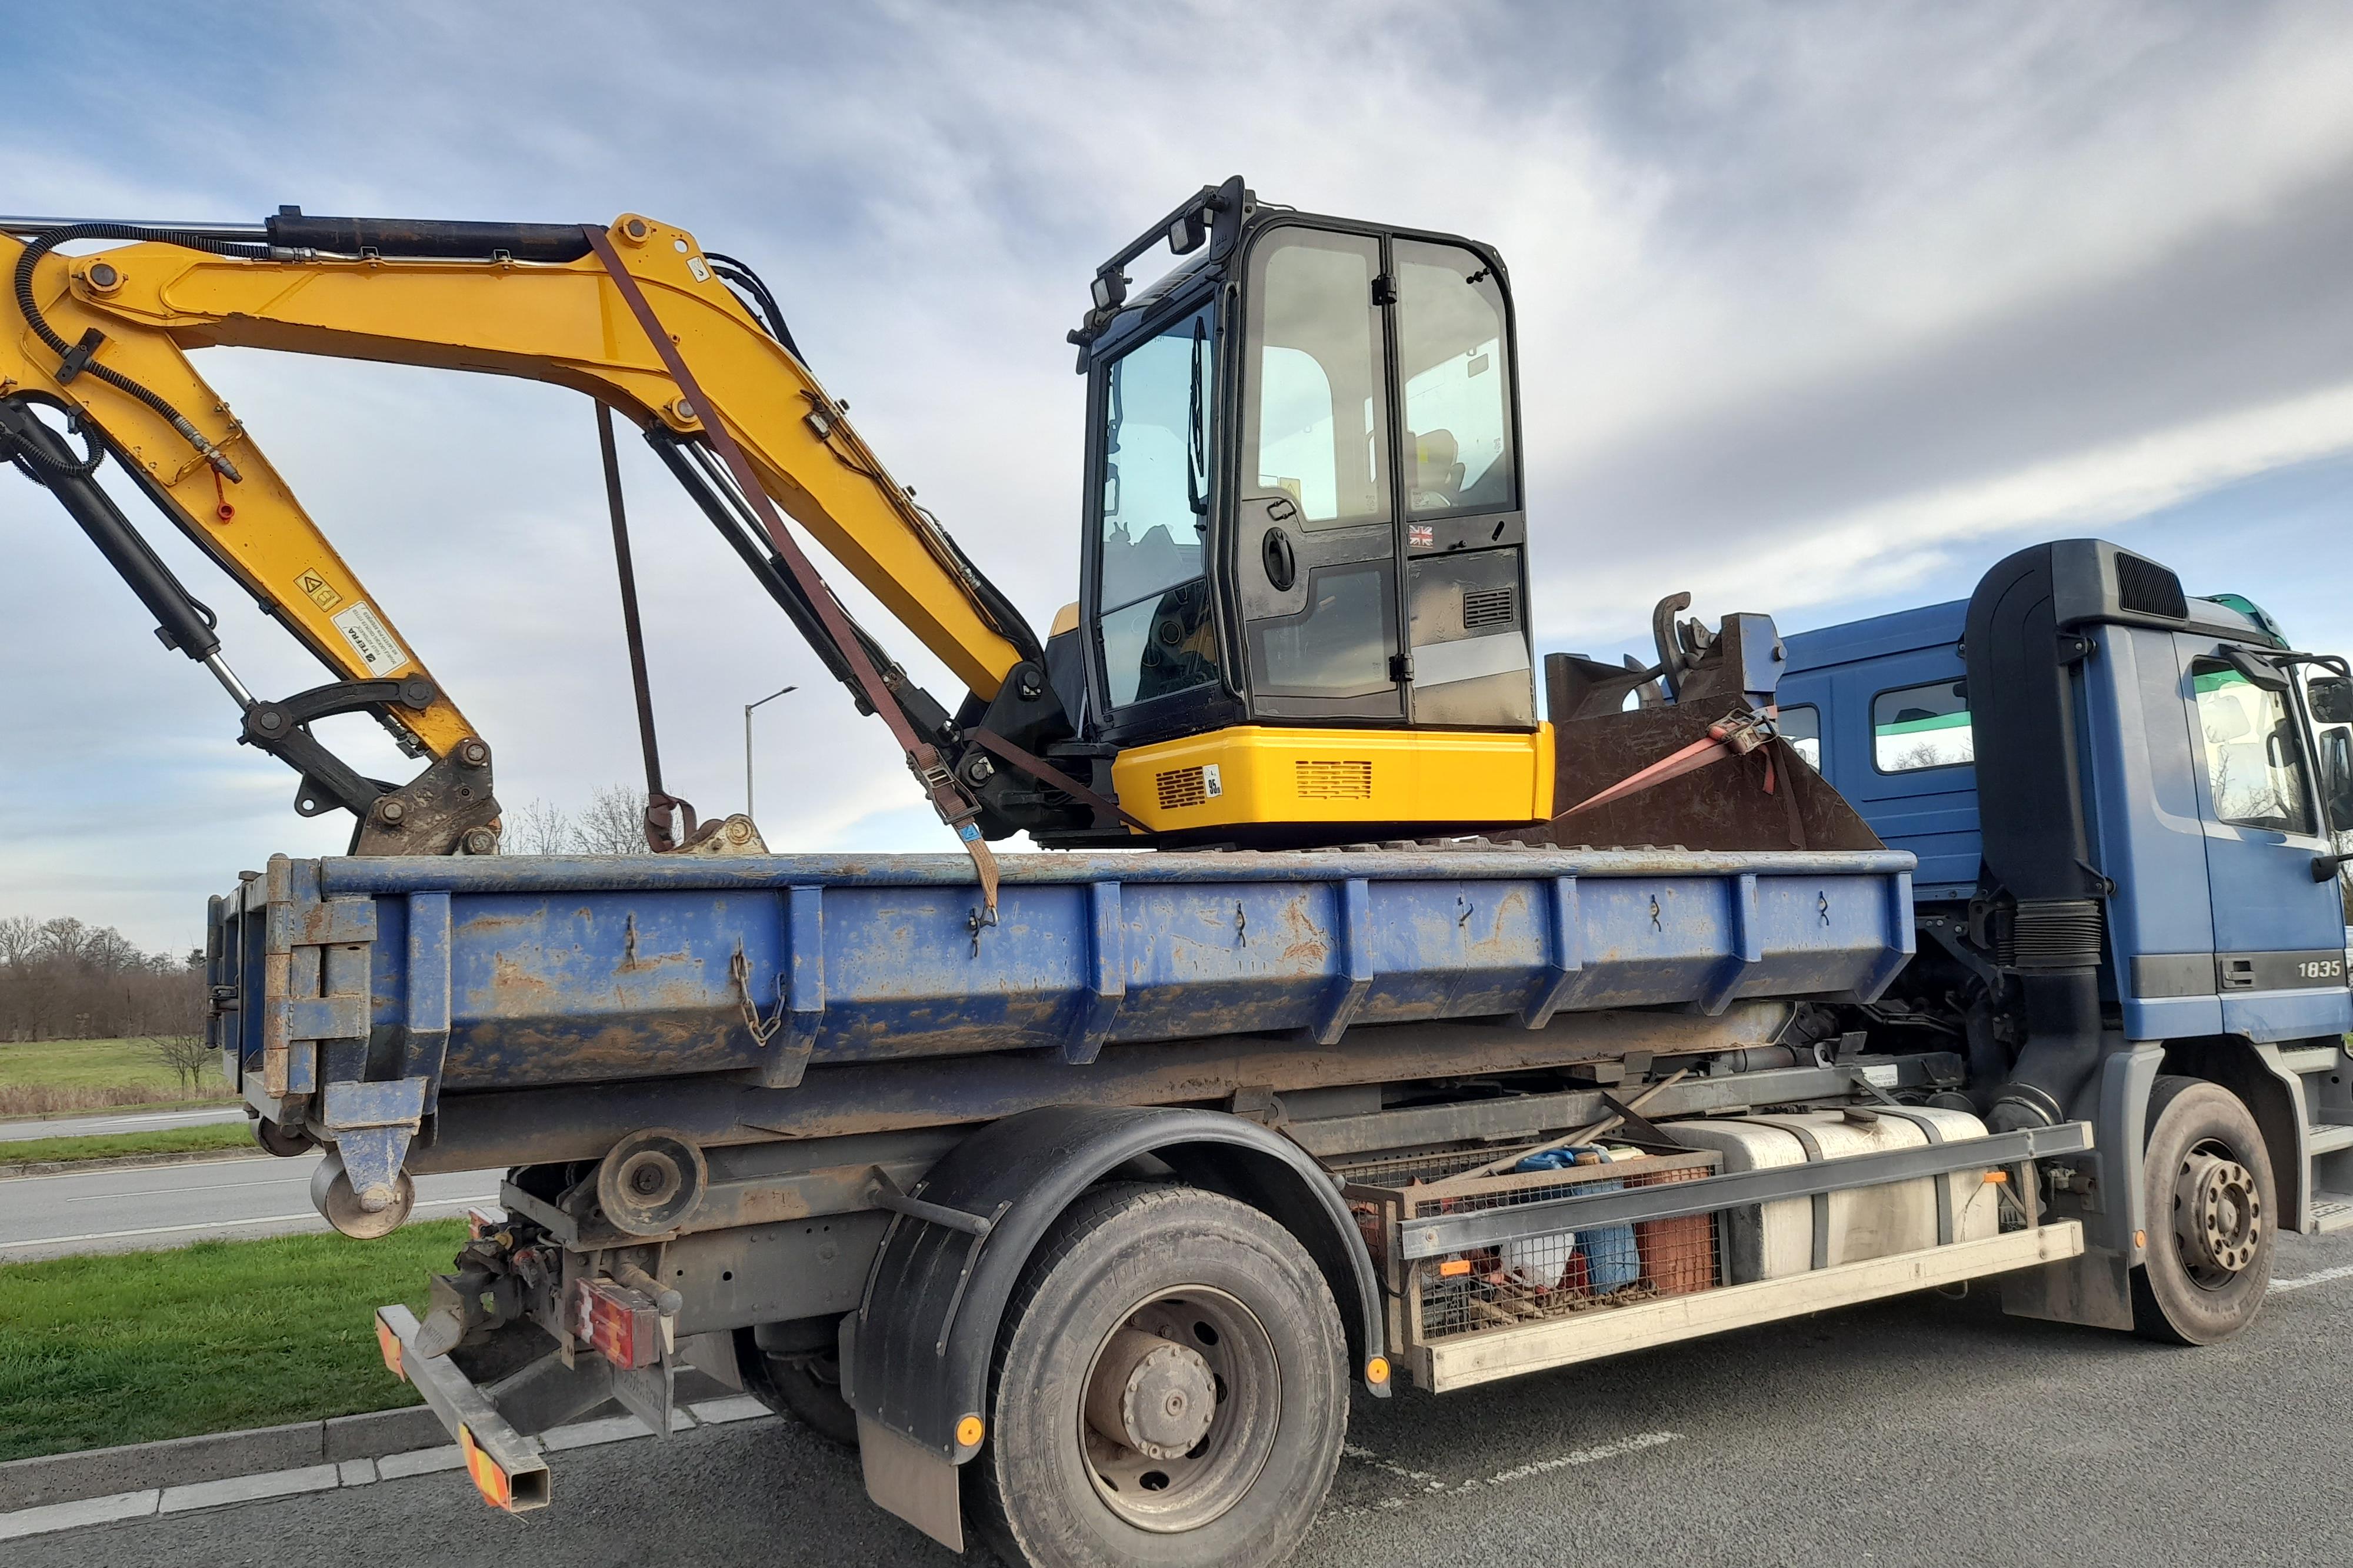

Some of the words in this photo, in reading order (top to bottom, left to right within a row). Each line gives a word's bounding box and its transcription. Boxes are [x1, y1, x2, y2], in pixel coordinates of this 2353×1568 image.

[348, 628, 369, 653] TEFRA
[1208, 779, 1217, 794] 95
[2298, 960, 2341, 978] 1835
